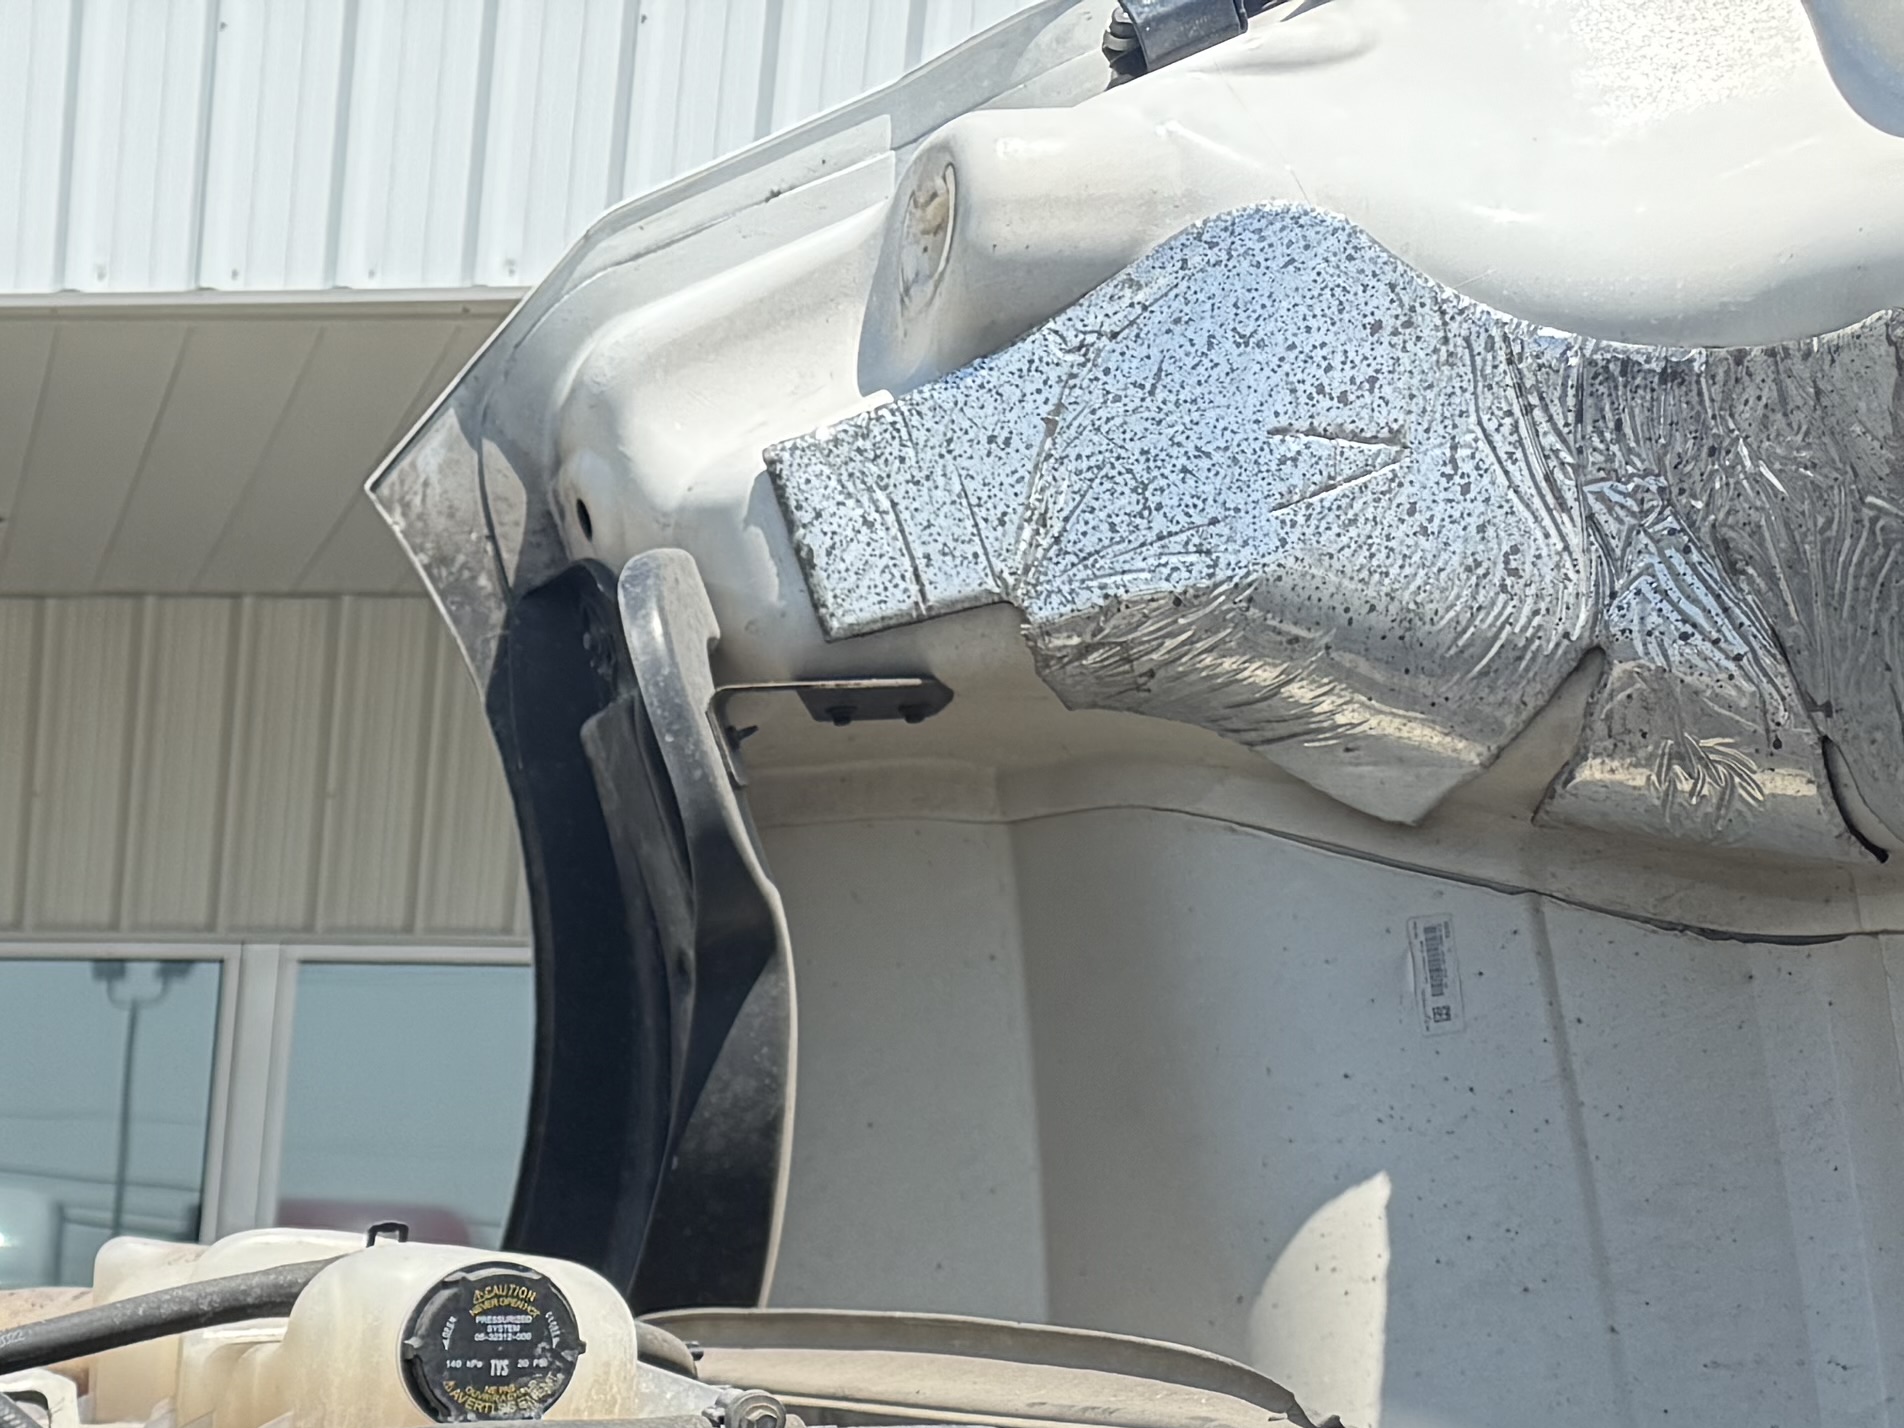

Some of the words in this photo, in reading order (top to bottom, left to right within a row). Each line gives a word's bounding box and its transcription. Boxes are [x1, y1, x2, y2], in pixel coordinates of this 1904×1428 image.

[484, 1283, 537, 1302] CAUTION
[475, 1314, 533, 1324] PRESSURIZED
[486, 1324, 521, 1333] SYSTEM
[446, 1359, 462, 1369] 140
[490, 1359, 509, 1377] TVS
[517, 1359, 530, 1369] 20
